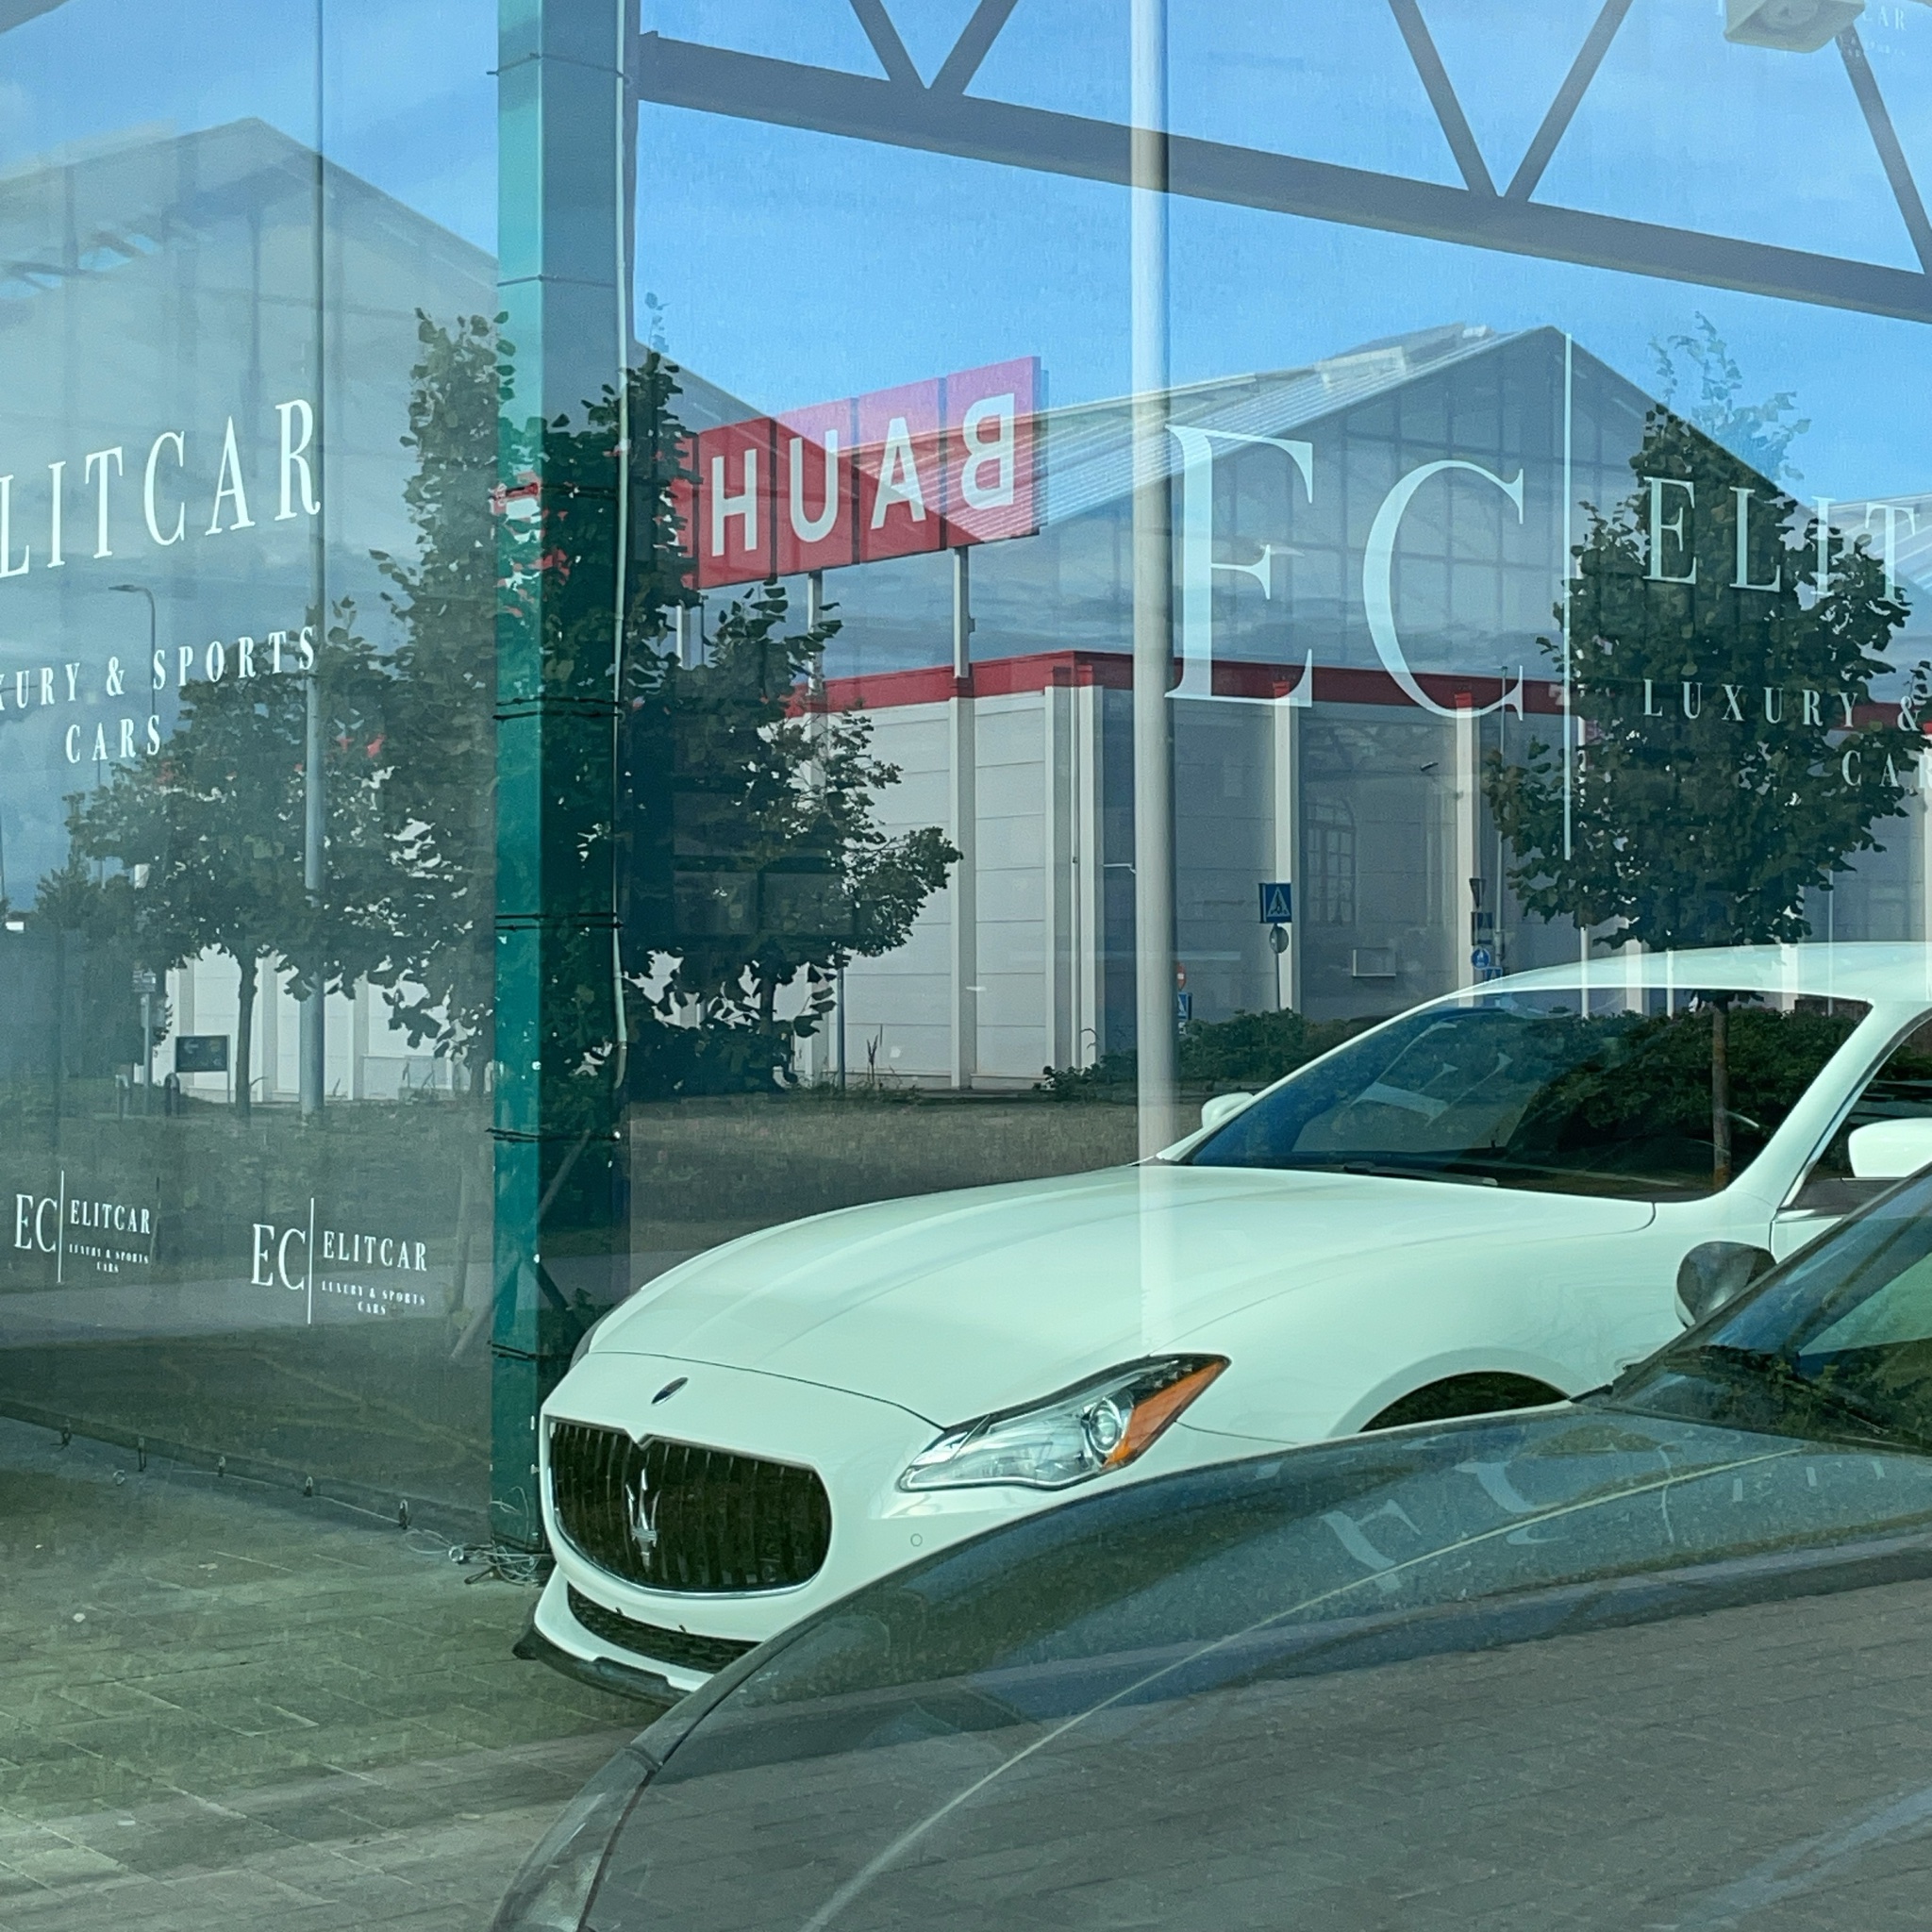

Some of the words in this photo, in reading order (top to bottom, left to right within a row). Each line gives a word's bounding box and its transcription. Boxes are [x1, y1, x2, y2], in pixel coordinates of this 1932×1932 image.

[1642, 475, 1916, 606] ELIT
[1164, 424, 1524, 722] EC
[106, 656, 125, 696] &
[153, 625, 315, 691] SPORTS
[1643, 679, 1858, 728] LUXURY
[1896, 695, 1922, 733] &
[65, 714, 161, 764] CARS
[14, 1193, 58, 1253] EC
[70, 1199, 151, 1235] ELITCAR
[251, 1224, 307, 1291] EC
[323, 1230, 427, 1272] ELITCAR
